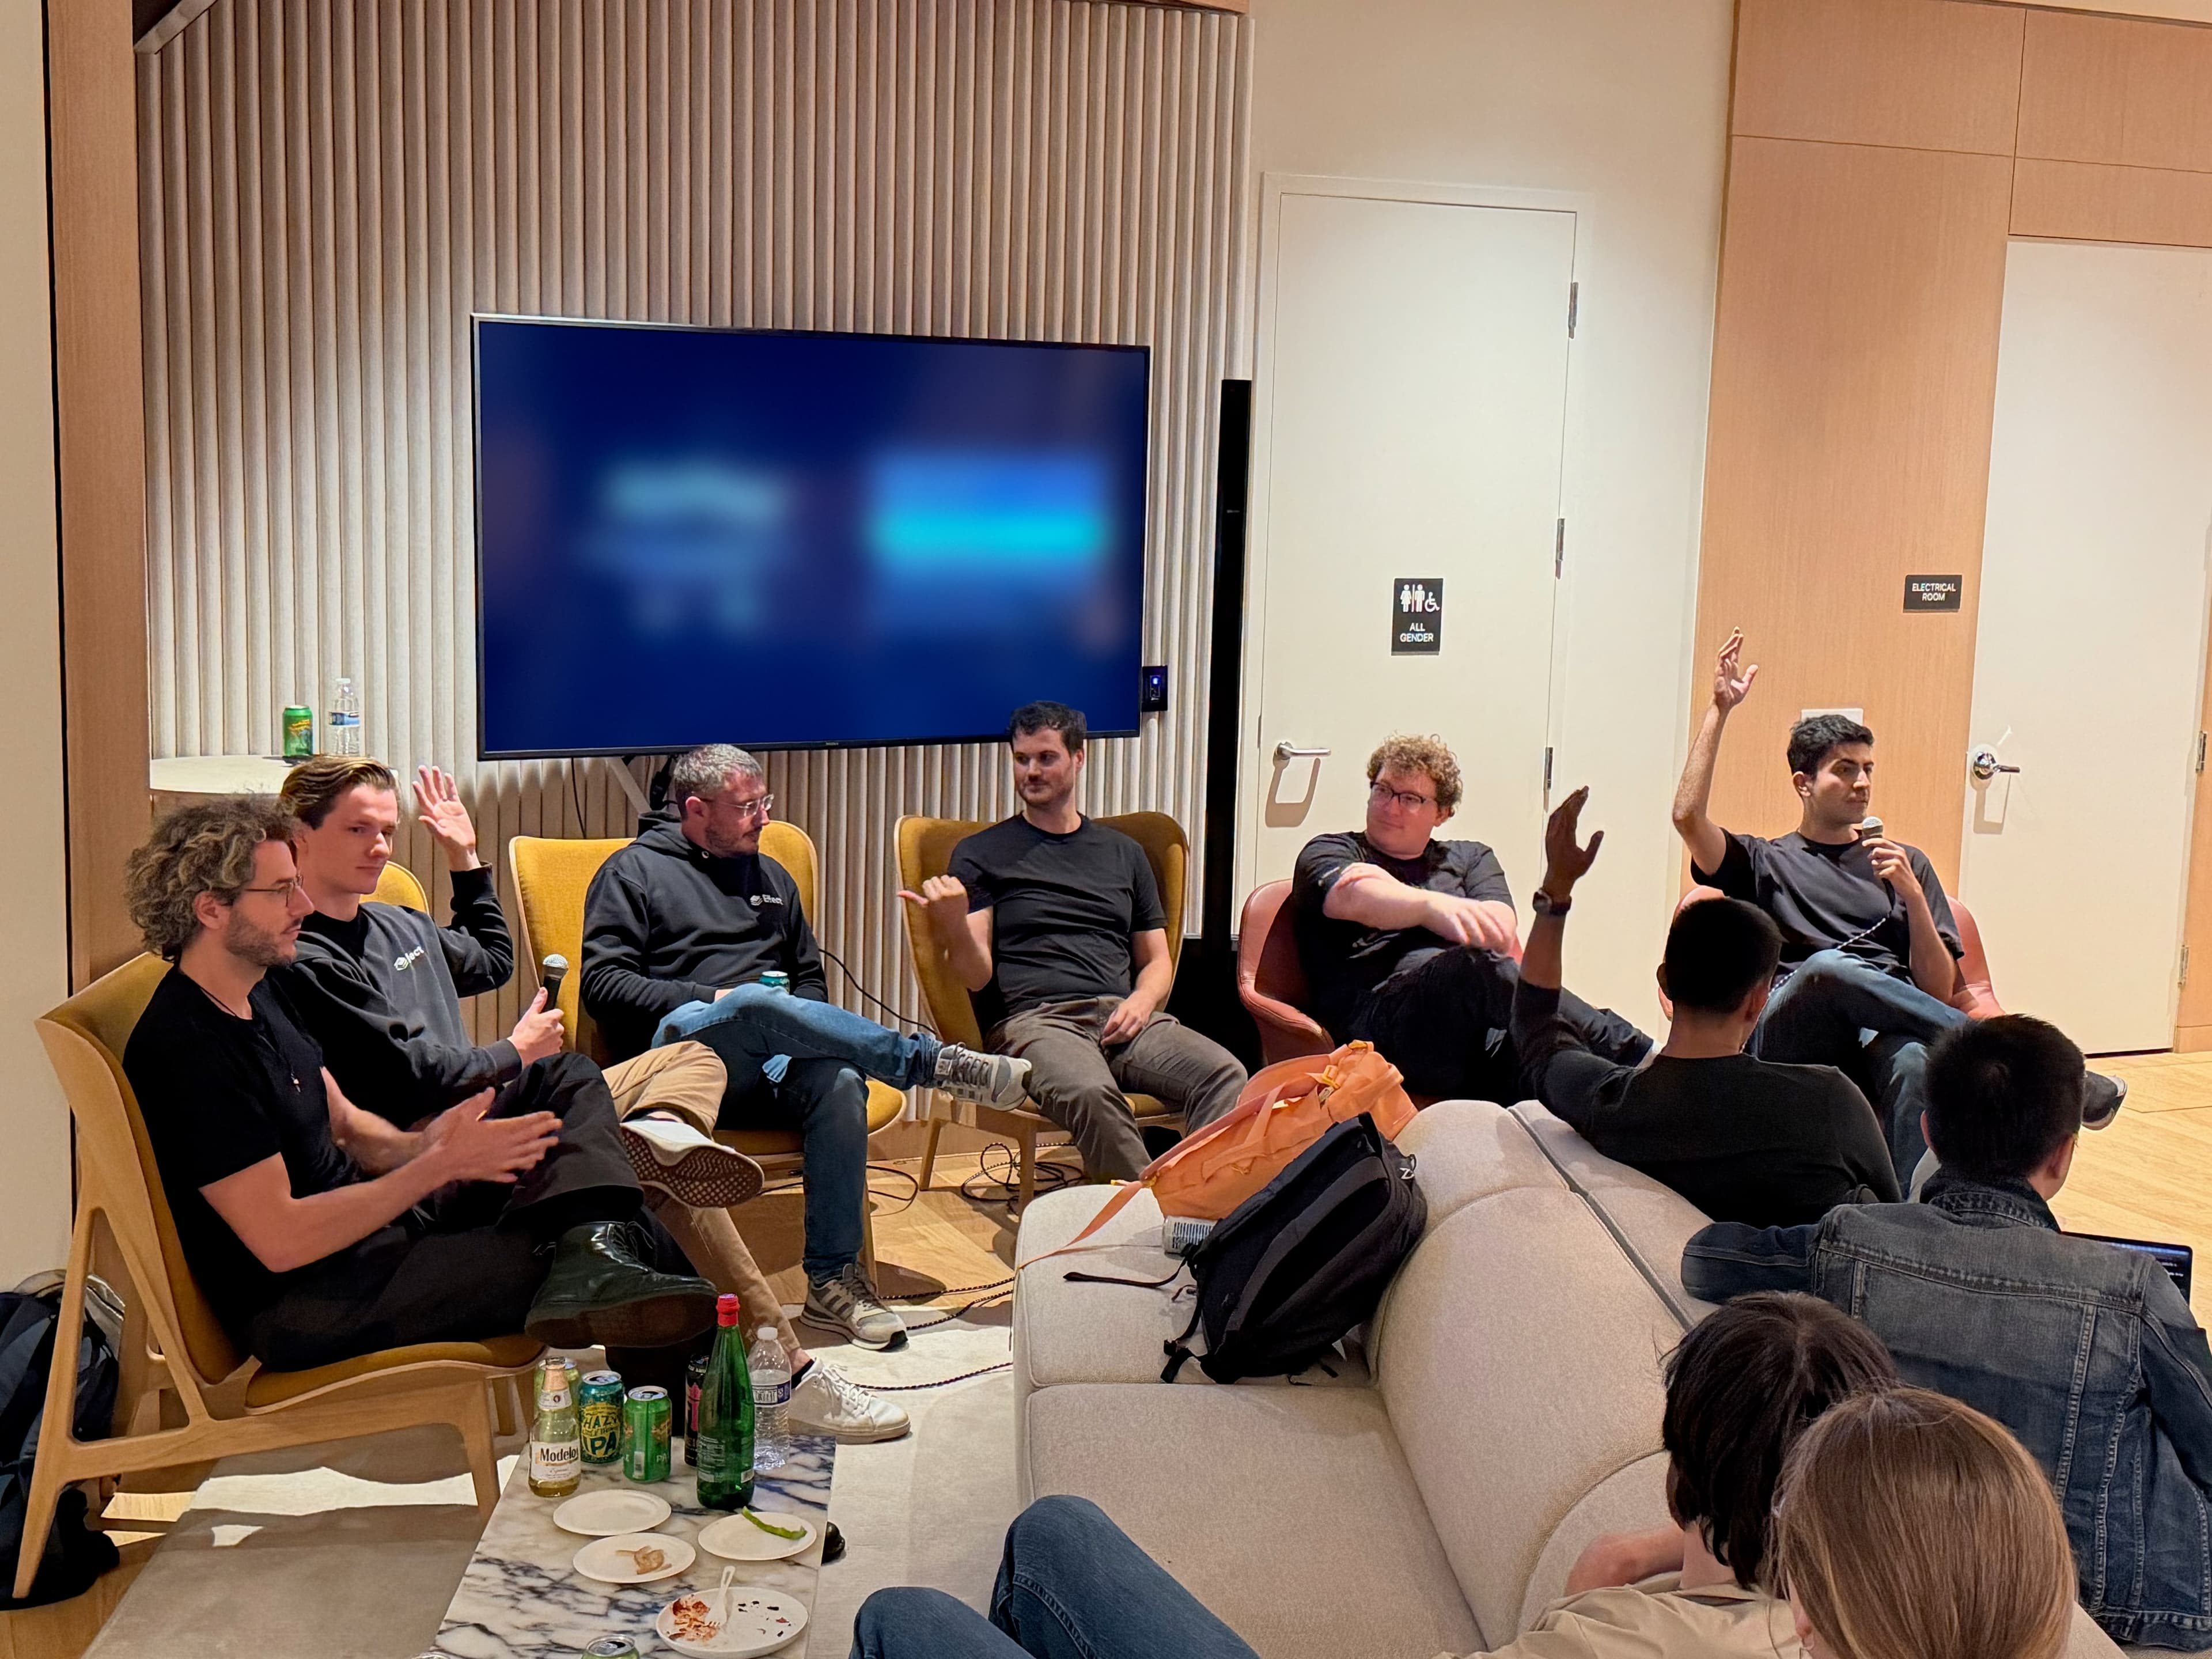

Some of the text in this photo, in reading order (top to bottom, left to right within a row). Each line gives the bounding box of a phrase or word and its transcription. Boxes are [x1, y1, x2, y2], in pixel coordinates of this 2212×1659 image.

[1912, 582, 1956, 592] ELECTRICAL
[1922, 593, 1946, 601] ROOM
[1409, 623, 1426, 631] ALL
[1400, 633, 1434, 642] GENDER
[582, 1431, 617, 1456] IPA
[540, 1446, 576, 1461] Modelo
